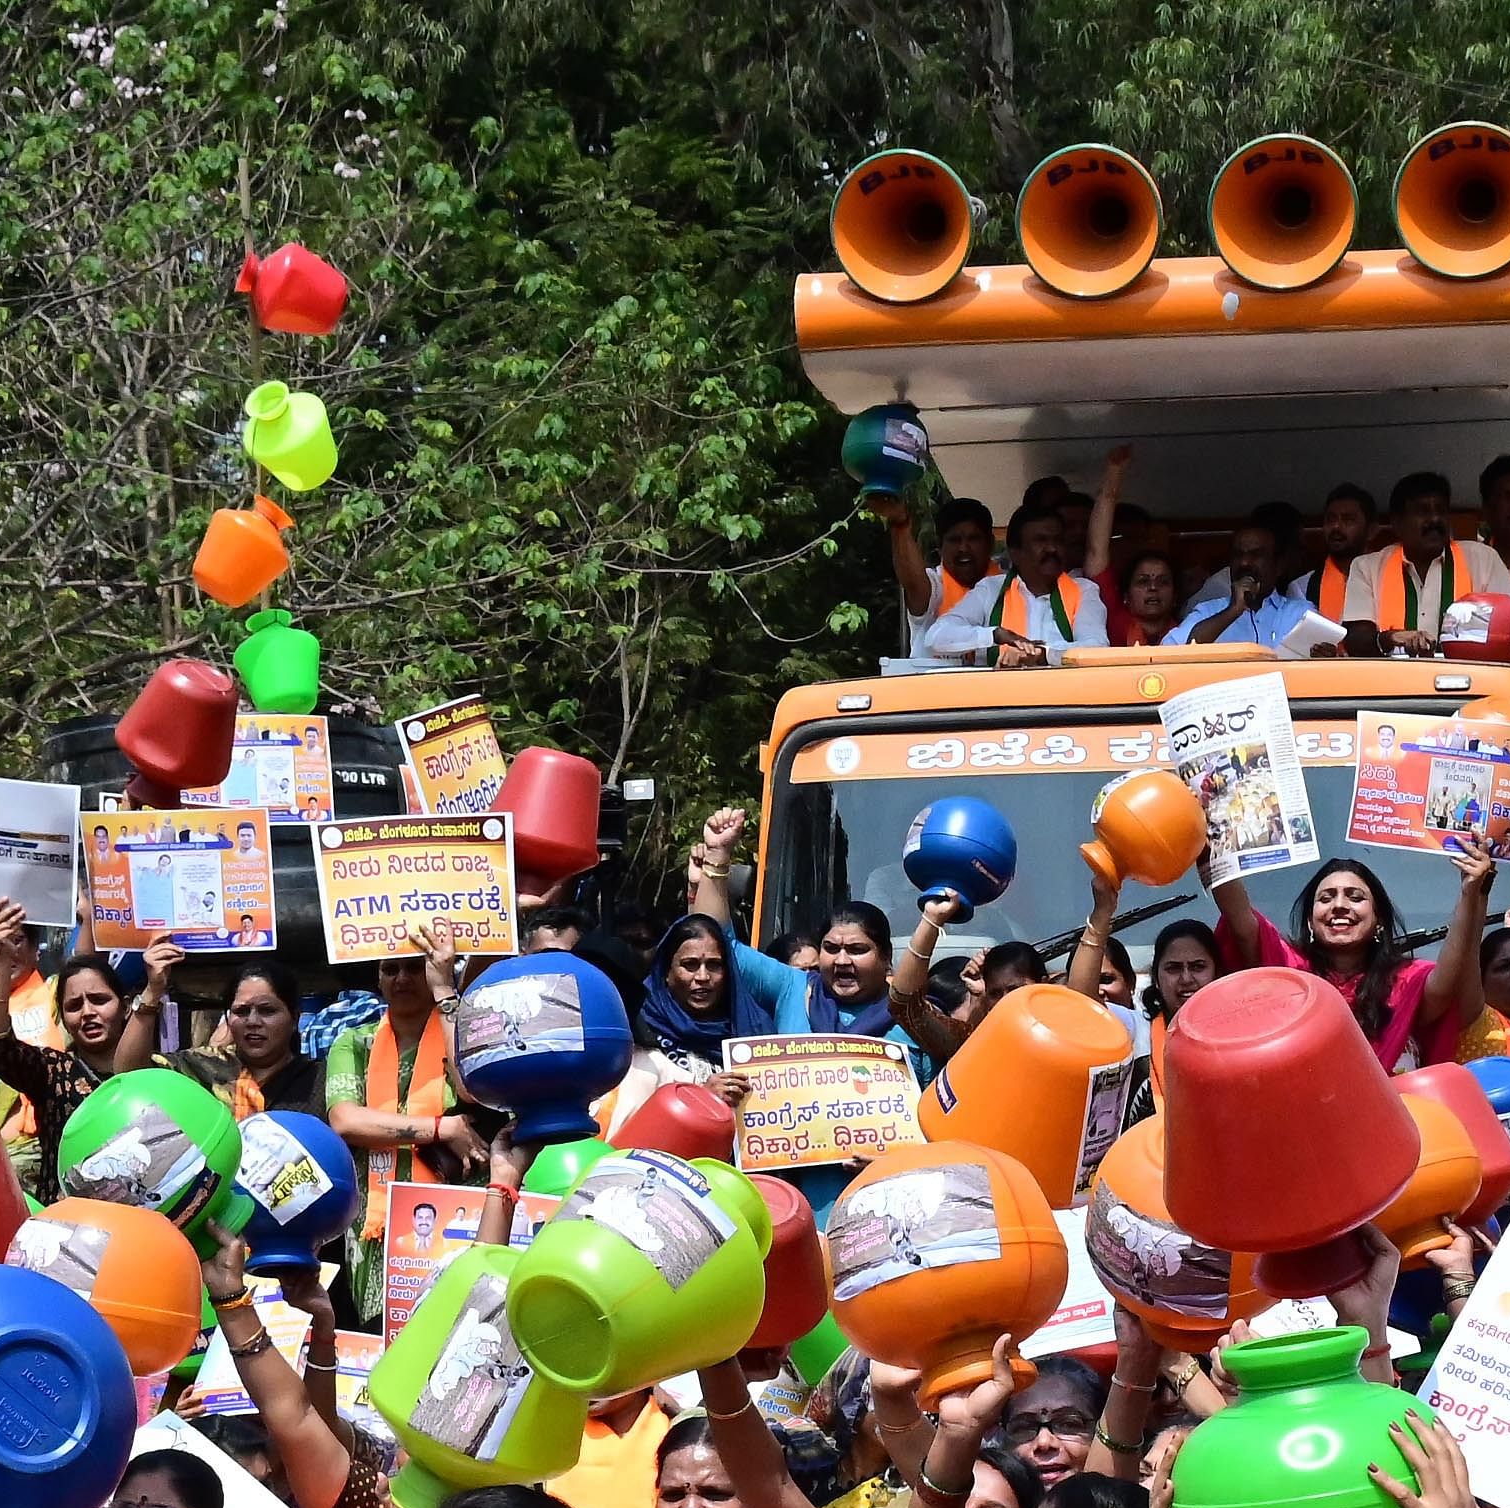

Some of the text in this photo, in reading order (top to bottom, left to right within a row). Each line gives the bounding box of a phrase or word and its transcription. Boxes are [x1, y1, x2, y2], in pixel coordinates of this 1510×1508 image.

[906, 731, 1088, 771] ಬಿಜೆಪಿ
[361, 773, 386, 786] LTR
[1360, 762, 1398, 790] ಸಿದ್ದು
[332, 851, 496, 882] ನೀರು ನೀಡದ ರಾಜ್ಯ
[334, 886, 507, 921] ATM ಸರ್ಕಾರಕ್ಕೆ
[748, 1064, 911, 1099] ನ್ನಡಿಗರಿಗೆ ಖಾಲಿ ಕೊಟ್ಟ
[744, 1094, 912, 1130] ಕಾಂಗ್ರೆಸ್ ಸರ್ಕಾರಕ್ಕೆ
[1442, 1361, 1477, 1385] ನೀರು
